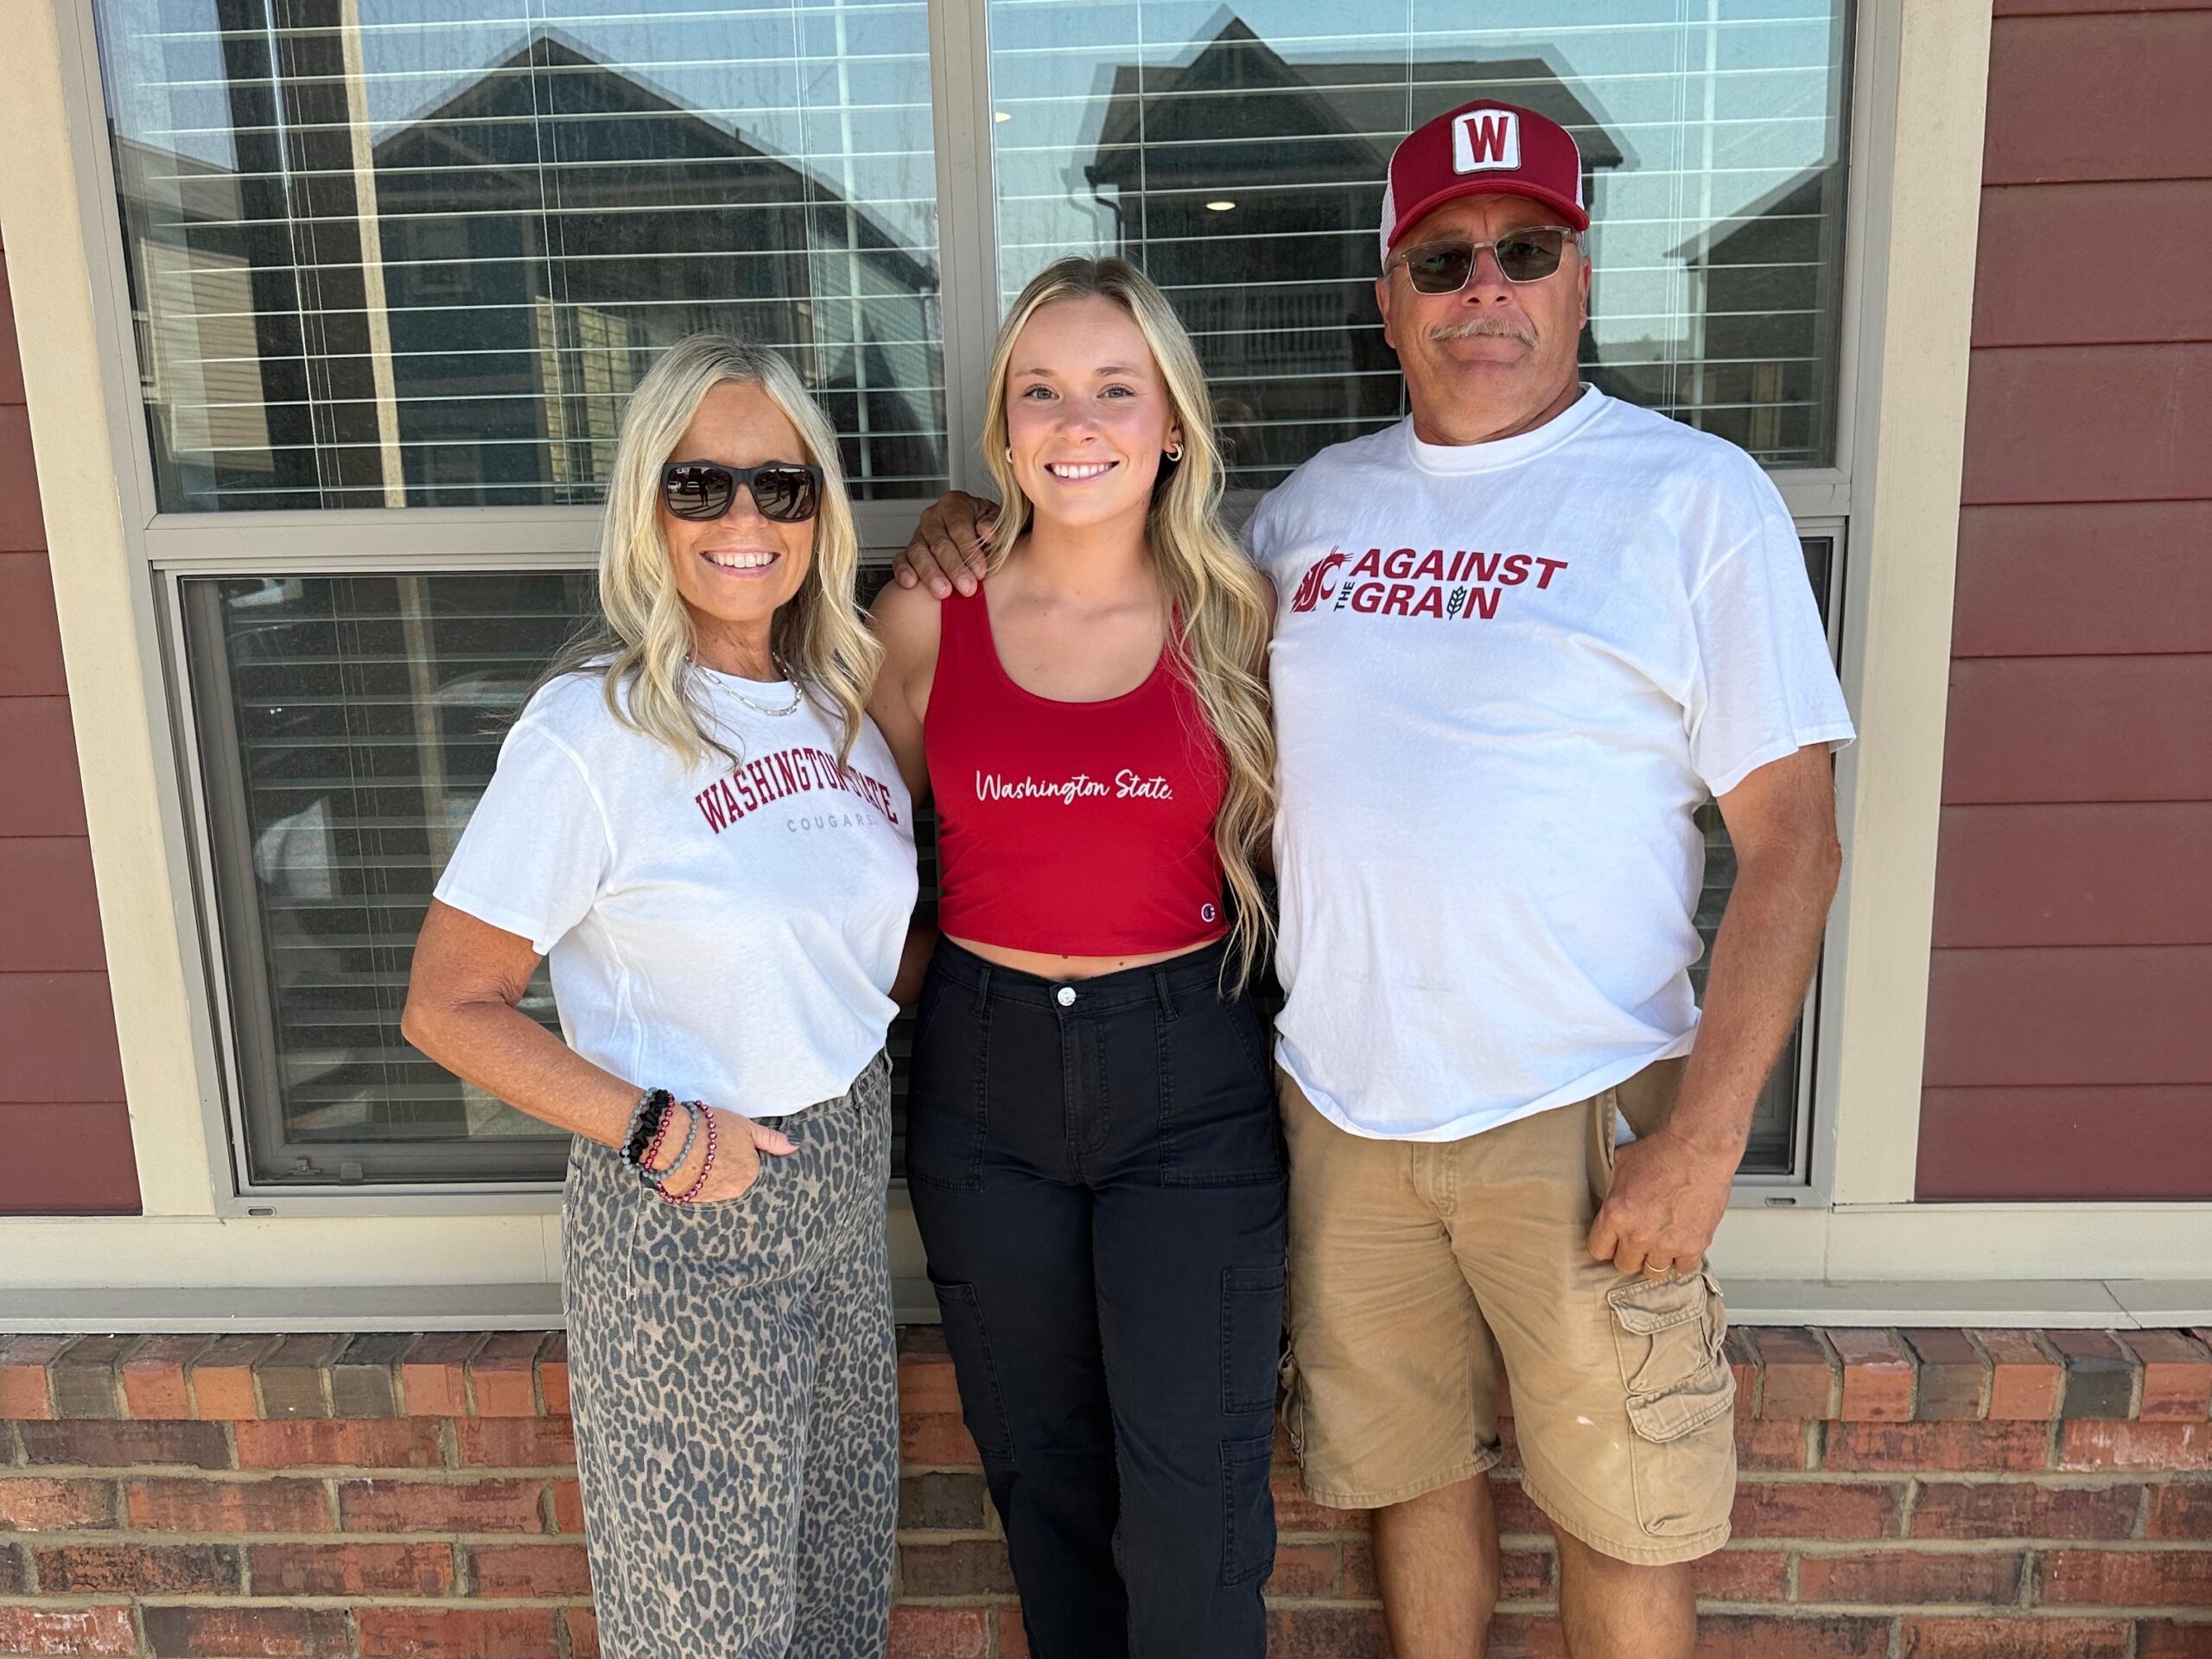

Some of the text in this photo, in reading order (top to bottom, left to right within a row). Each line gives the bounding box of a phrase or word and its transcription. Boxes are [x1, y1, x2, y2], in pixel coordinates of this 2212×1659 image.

[1463, 116, 1510, 163] W
[1349, 549, 1568, 589] AGAINST
[1333, 582, 1355, 612] THE
[695, 747, 849, 835] WASHINGTON
[976, 768, 1173, 805] Washington State
[786, 813, 874, 833] COUGARS
